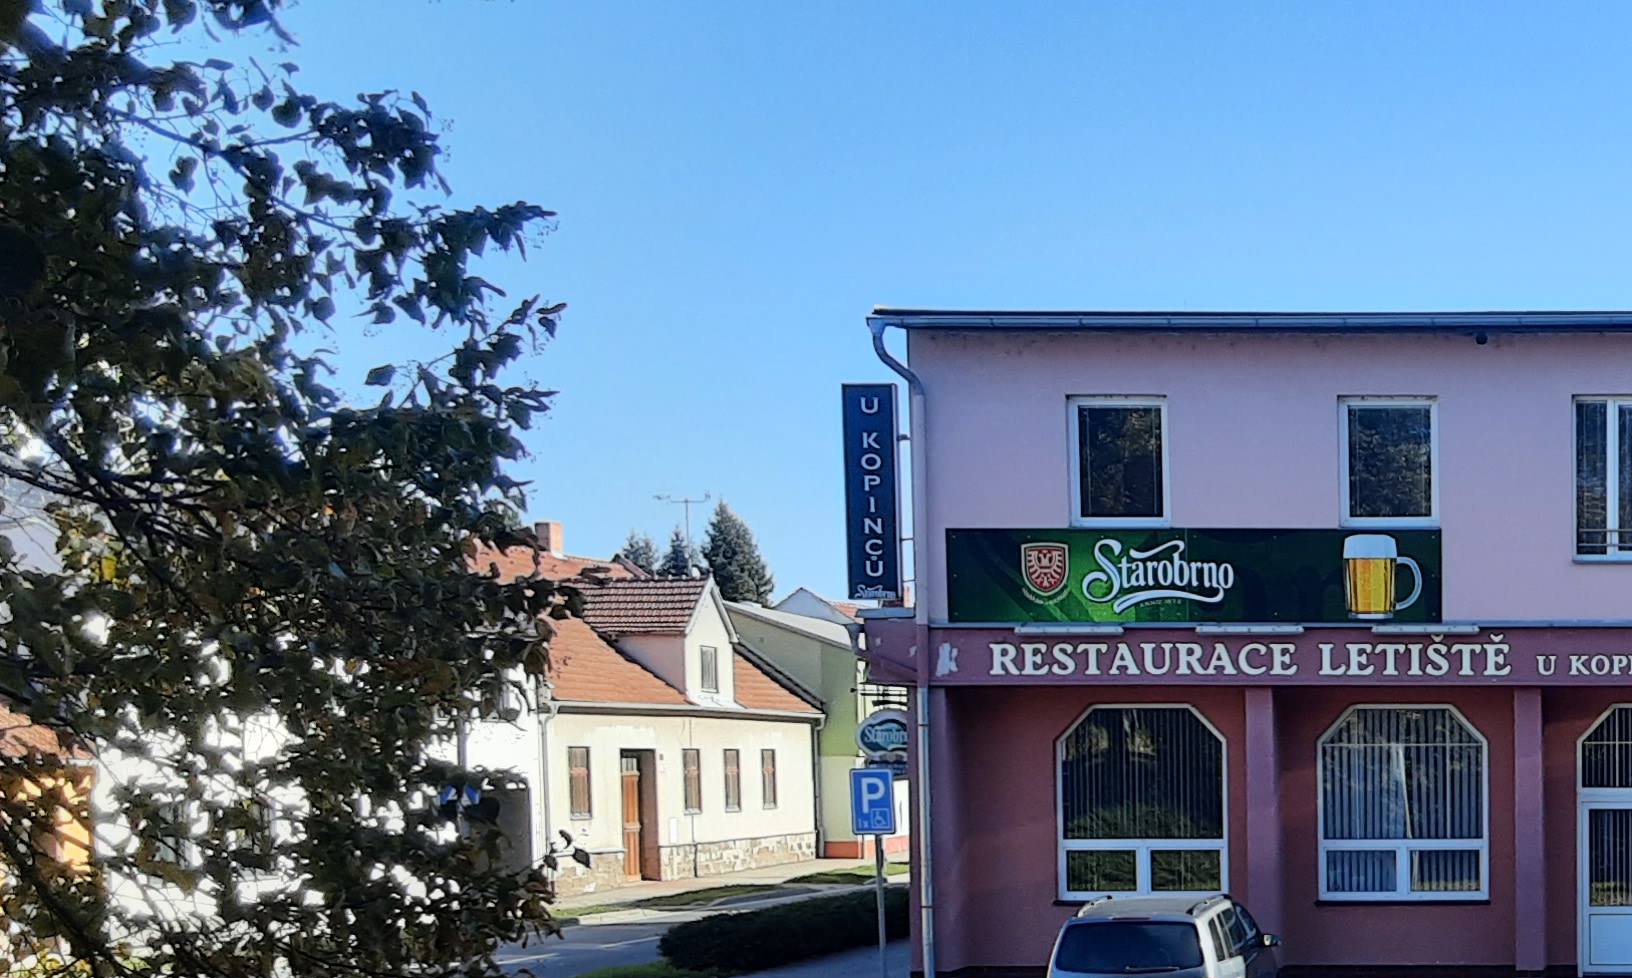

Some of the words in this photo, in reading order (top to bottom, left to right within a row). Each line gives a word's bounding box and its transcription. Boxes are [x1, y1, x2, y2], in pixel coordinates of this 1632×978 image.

[860, 396, 879, 414] U
[861, 431, 884, 577] KOPINCŮ
[1082, 538, 1235, 614] Starobrno
[988, 642, 1298, 675] RESTAURACE
[1317, 633, 1512, 676] LETIŠTĚ
[1536, 654, 1557, 675] U
[861, 776, 886, 814] P
